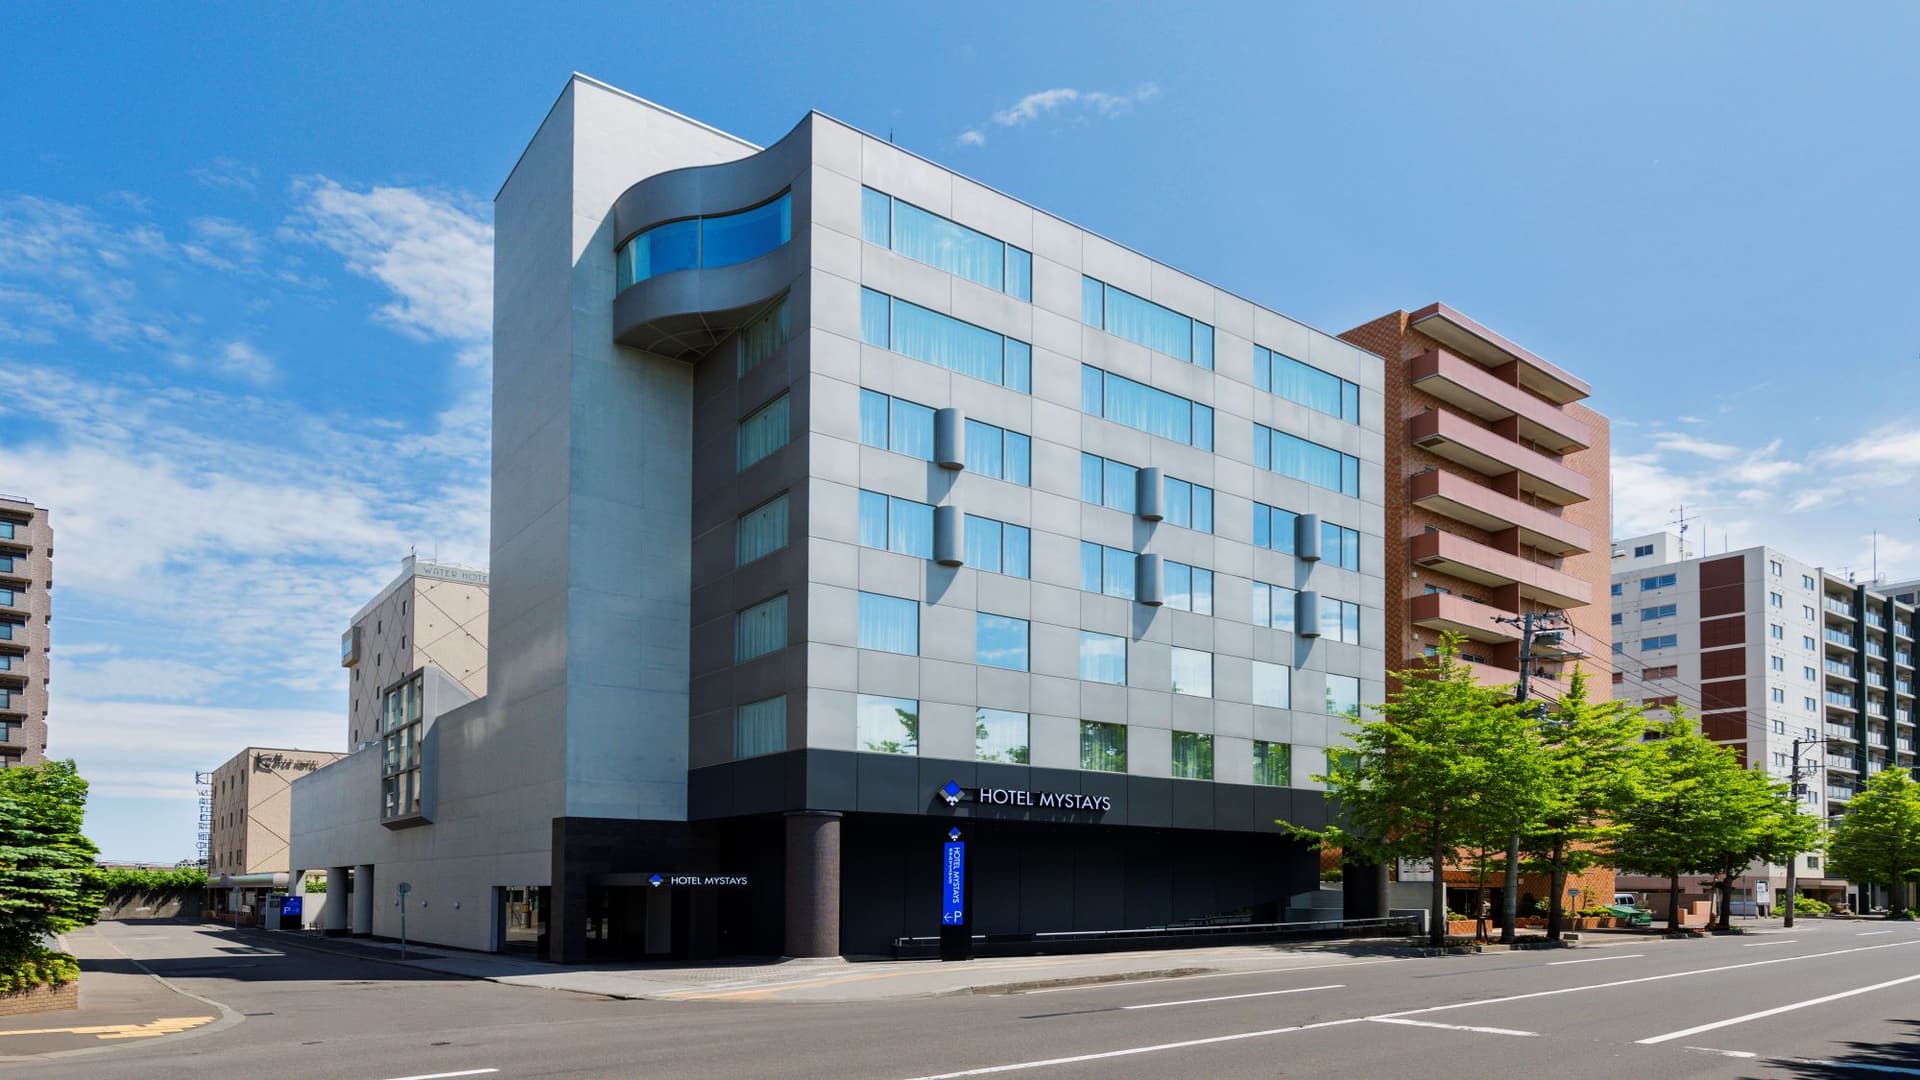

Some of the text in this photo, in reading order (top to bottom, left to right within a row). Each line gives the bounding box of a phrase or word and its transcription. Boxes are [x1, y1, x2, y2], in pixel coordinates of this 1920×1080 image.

[462, 572, 488, 583] HOTE
[980, 788, 1111, 811] HOTEL MYSTAYS
[671, 876, 748, 885] HOTEL MYSTAYS
[952, 847, 961, 904] HOTEL MYSTAYS
[283, 906, 291, 914] P
[954, 910, 962, 923] P
